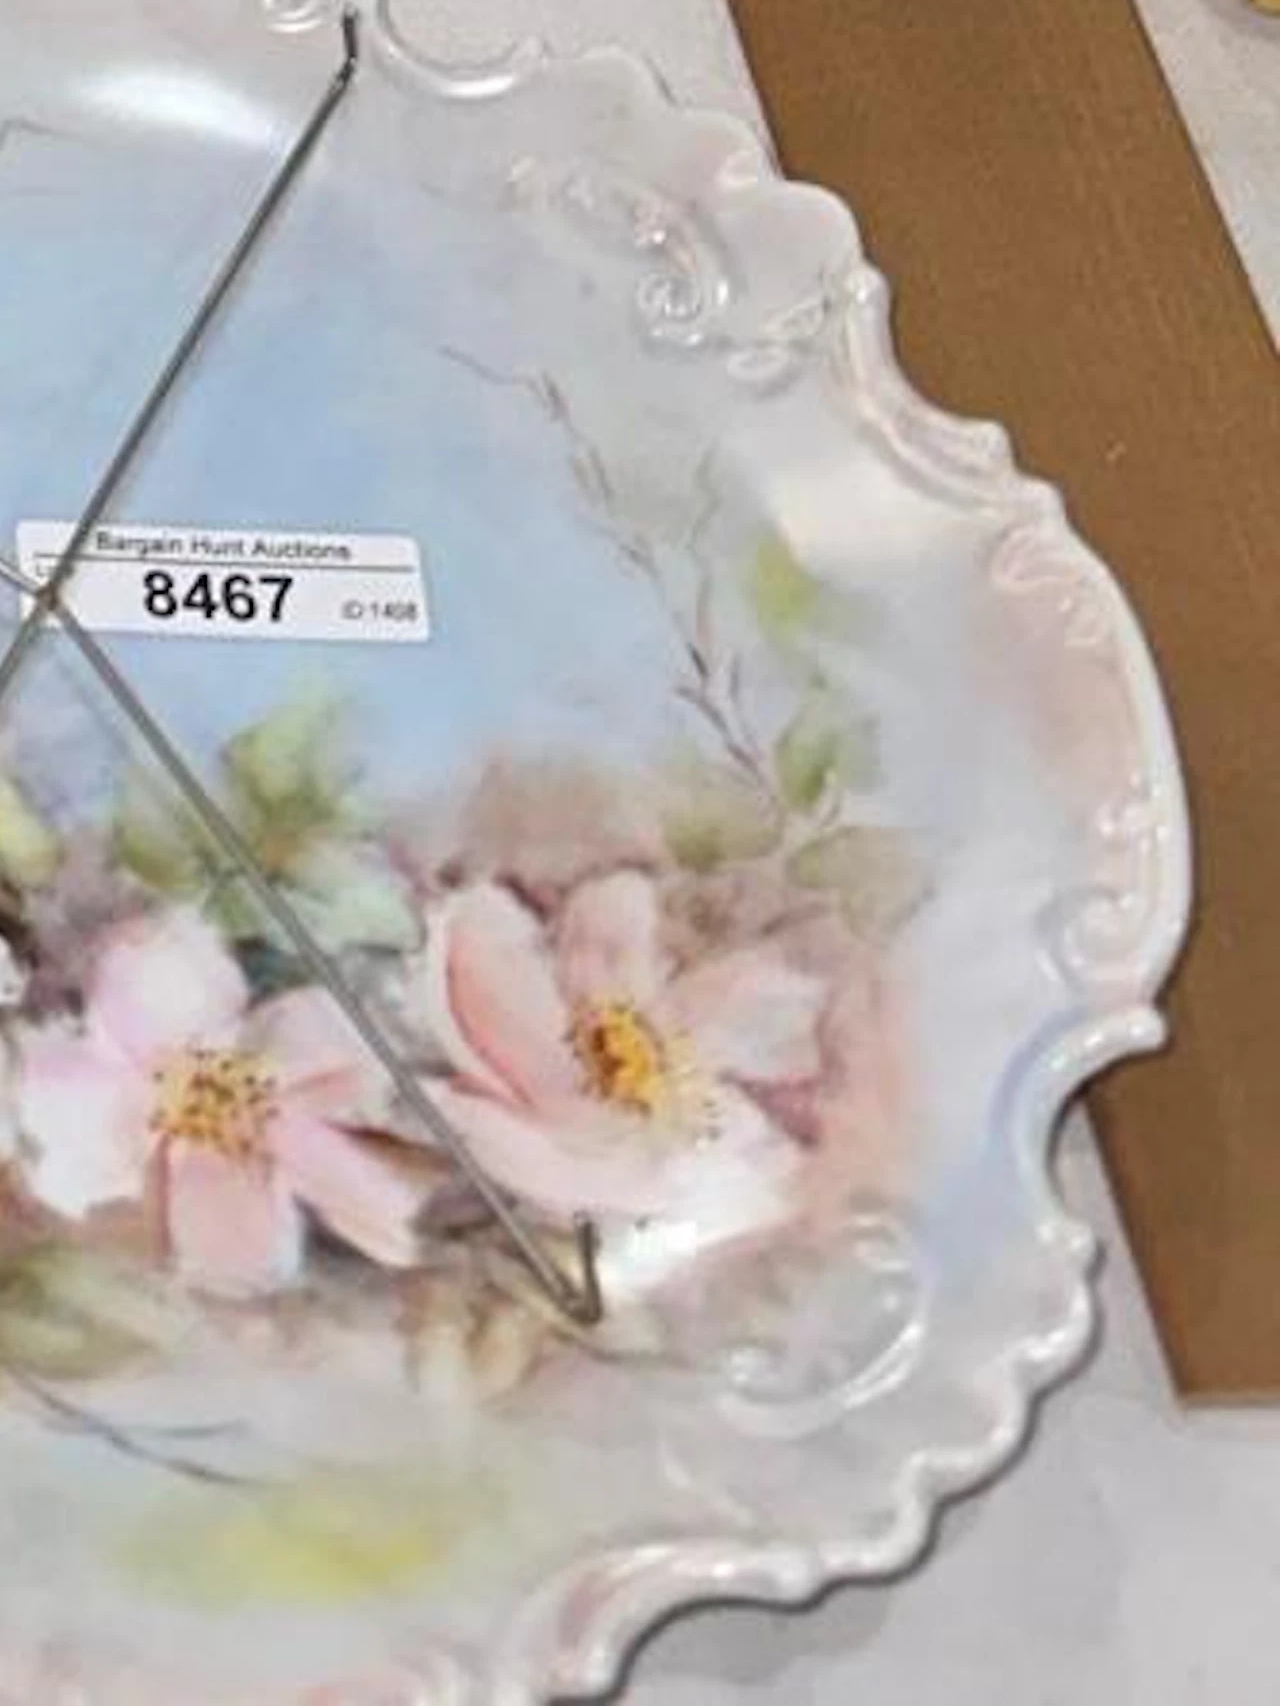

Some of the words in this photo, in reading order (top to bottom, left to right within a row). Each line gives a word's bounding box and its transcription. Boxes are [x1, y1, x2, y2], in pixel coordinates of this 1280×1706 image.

[96, 531, 183, 557] Bargain
[192, 538, 244, 558] Hunt
[252, 542, 352, 561] Auctions
[143, 570, 293, 621] 8467
